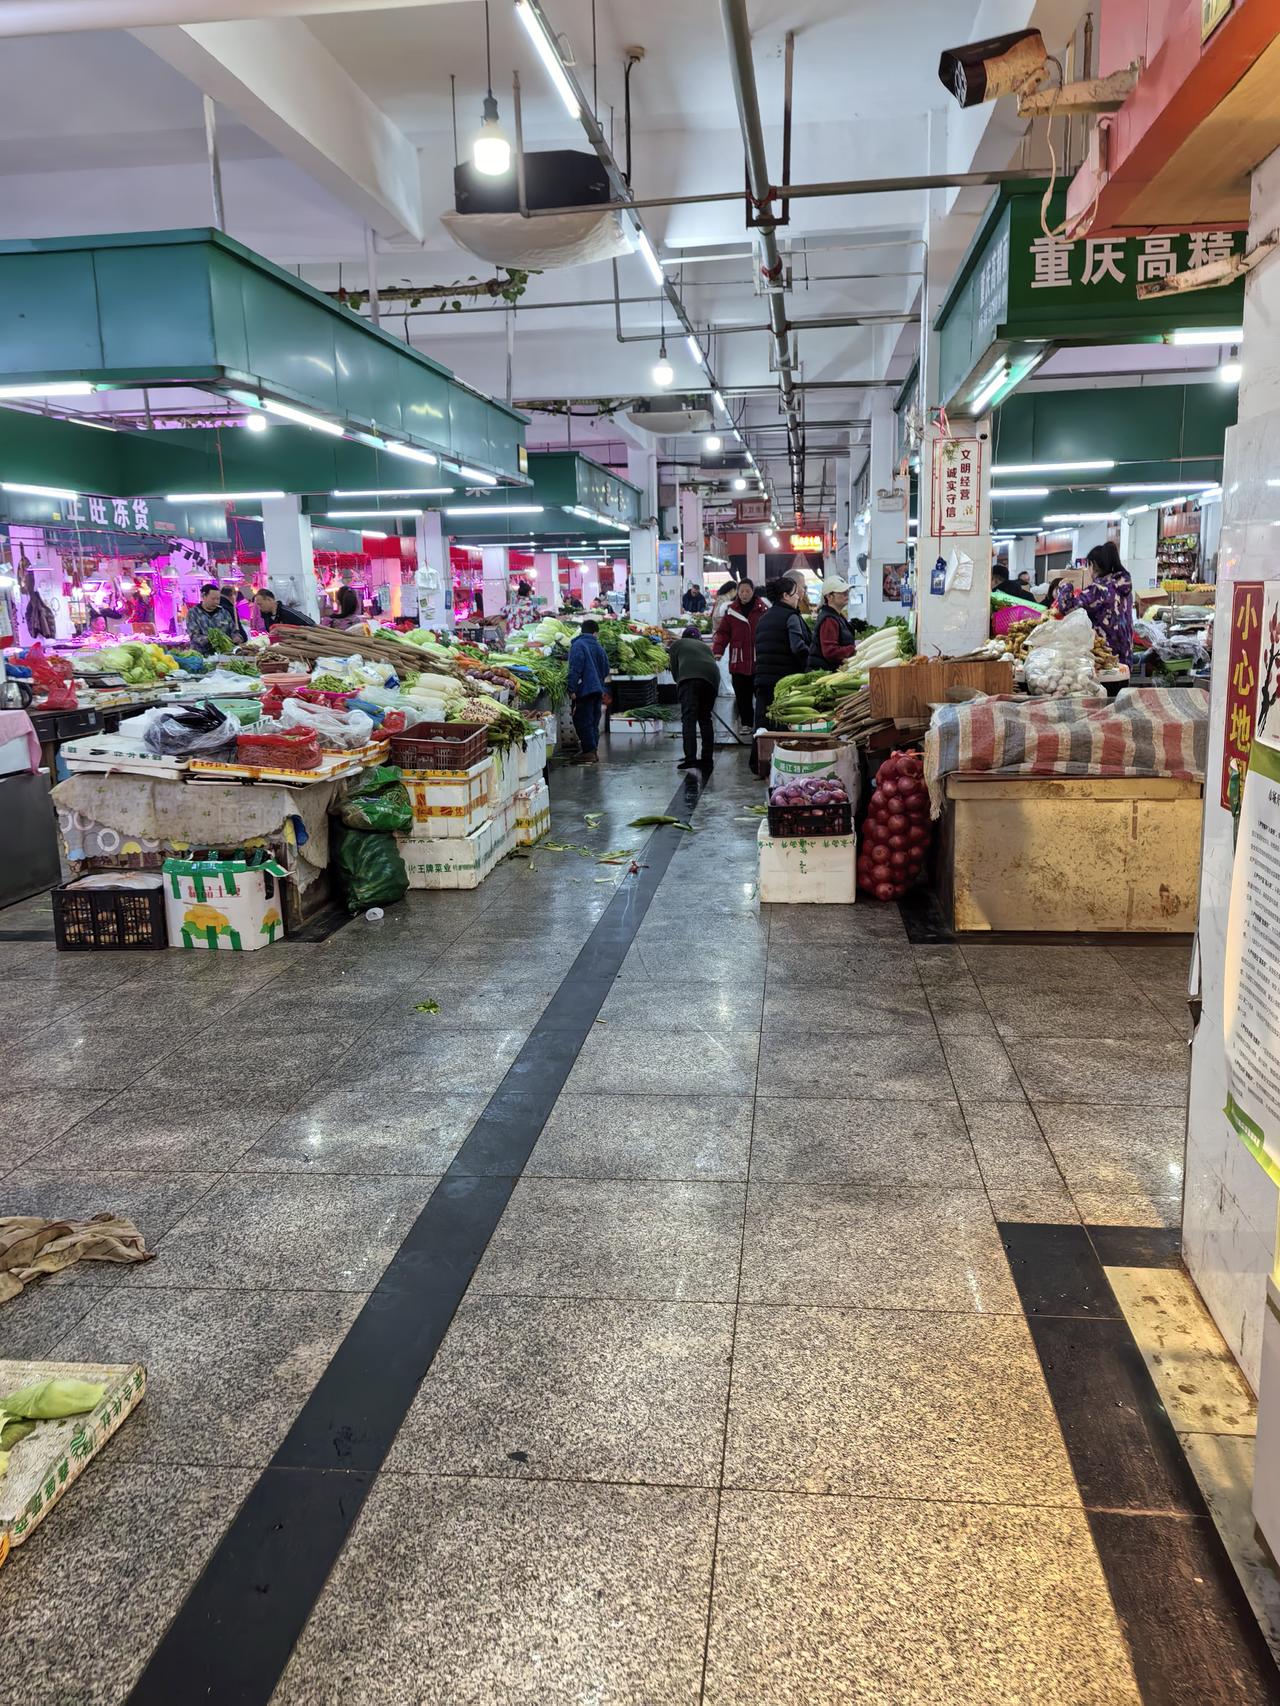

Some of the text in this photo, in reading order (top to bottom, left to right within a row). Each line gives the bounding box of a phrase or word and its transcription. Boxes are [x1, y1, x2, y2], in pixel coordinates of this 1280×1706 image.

[1029, 231, 1235, 288] 重庆高精
[945, 467, 958, 518] 诚实守信
[960, 449, 971, 501] 文明经营
